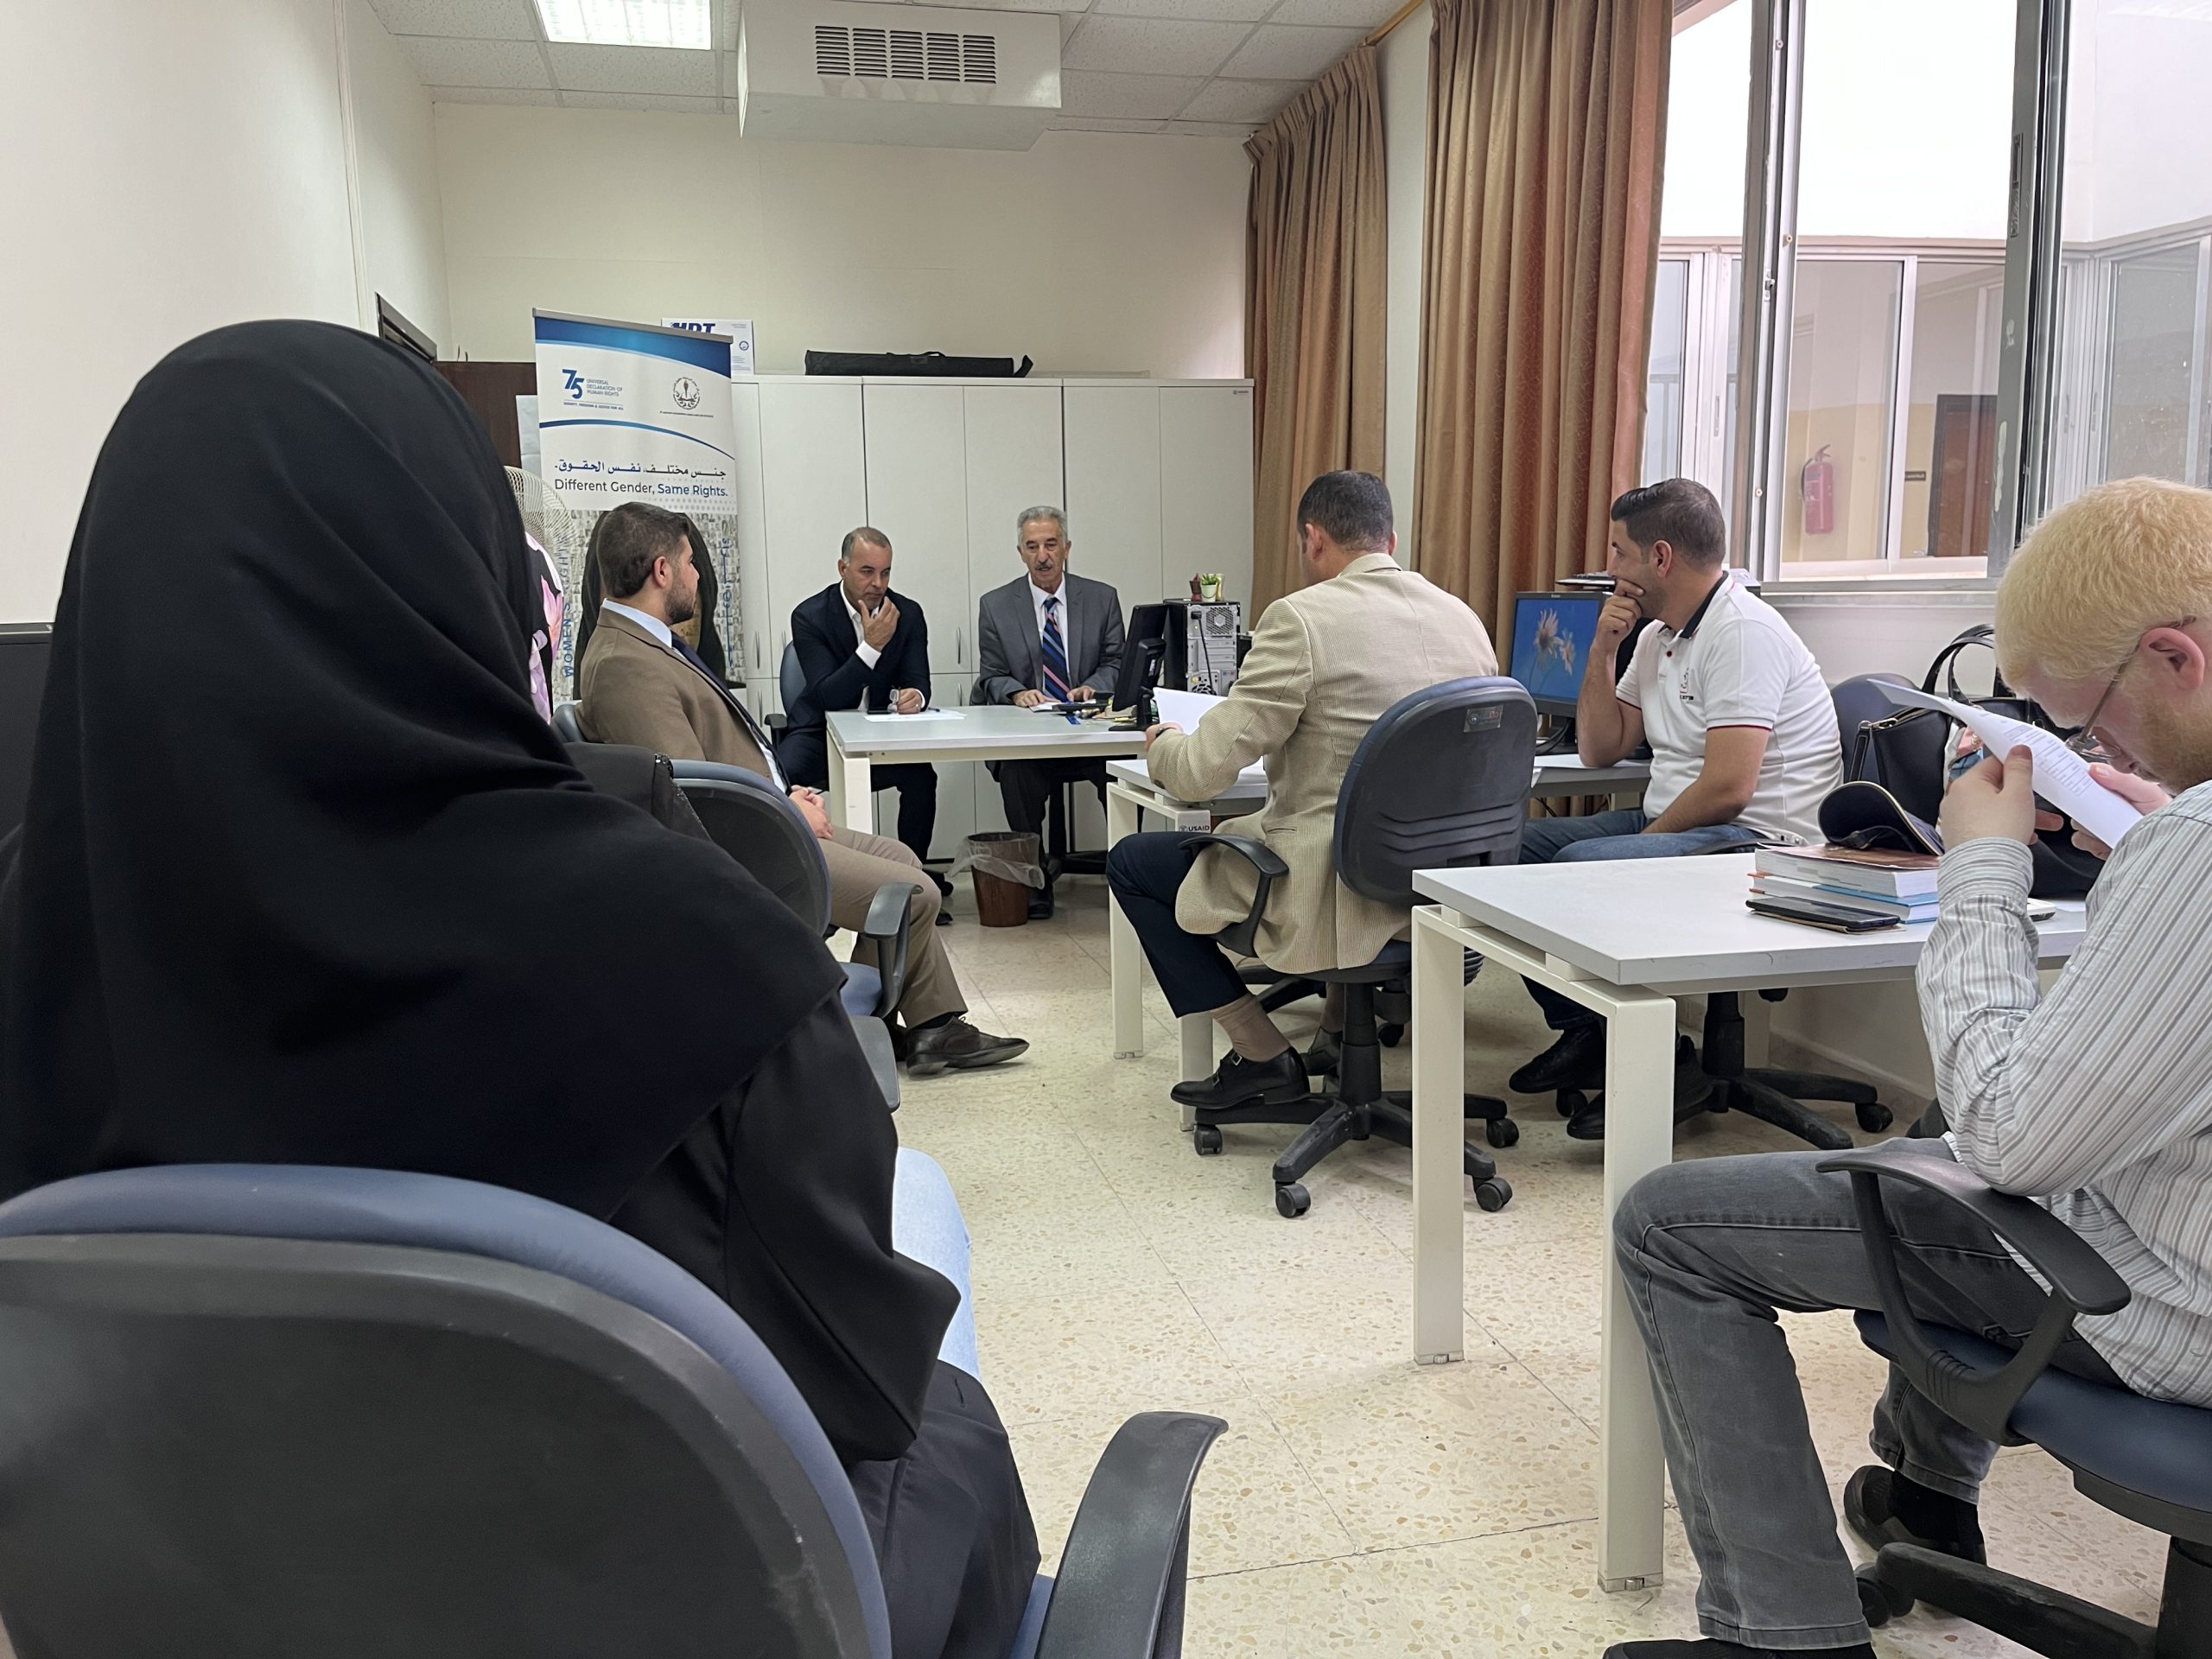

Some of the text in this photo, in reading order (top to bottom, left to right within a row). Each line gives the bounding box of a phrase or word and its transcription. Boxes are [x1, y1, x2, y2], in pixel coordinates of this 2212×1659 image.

[562, 369, 585, 399] 75
[607, 463, 641, 474] نفس
[691, 467, 727, 480] جنس
[555, 479, 728, 498] Different Gender, Same Rights.
[563, 602, 574, 677] WOMENS
